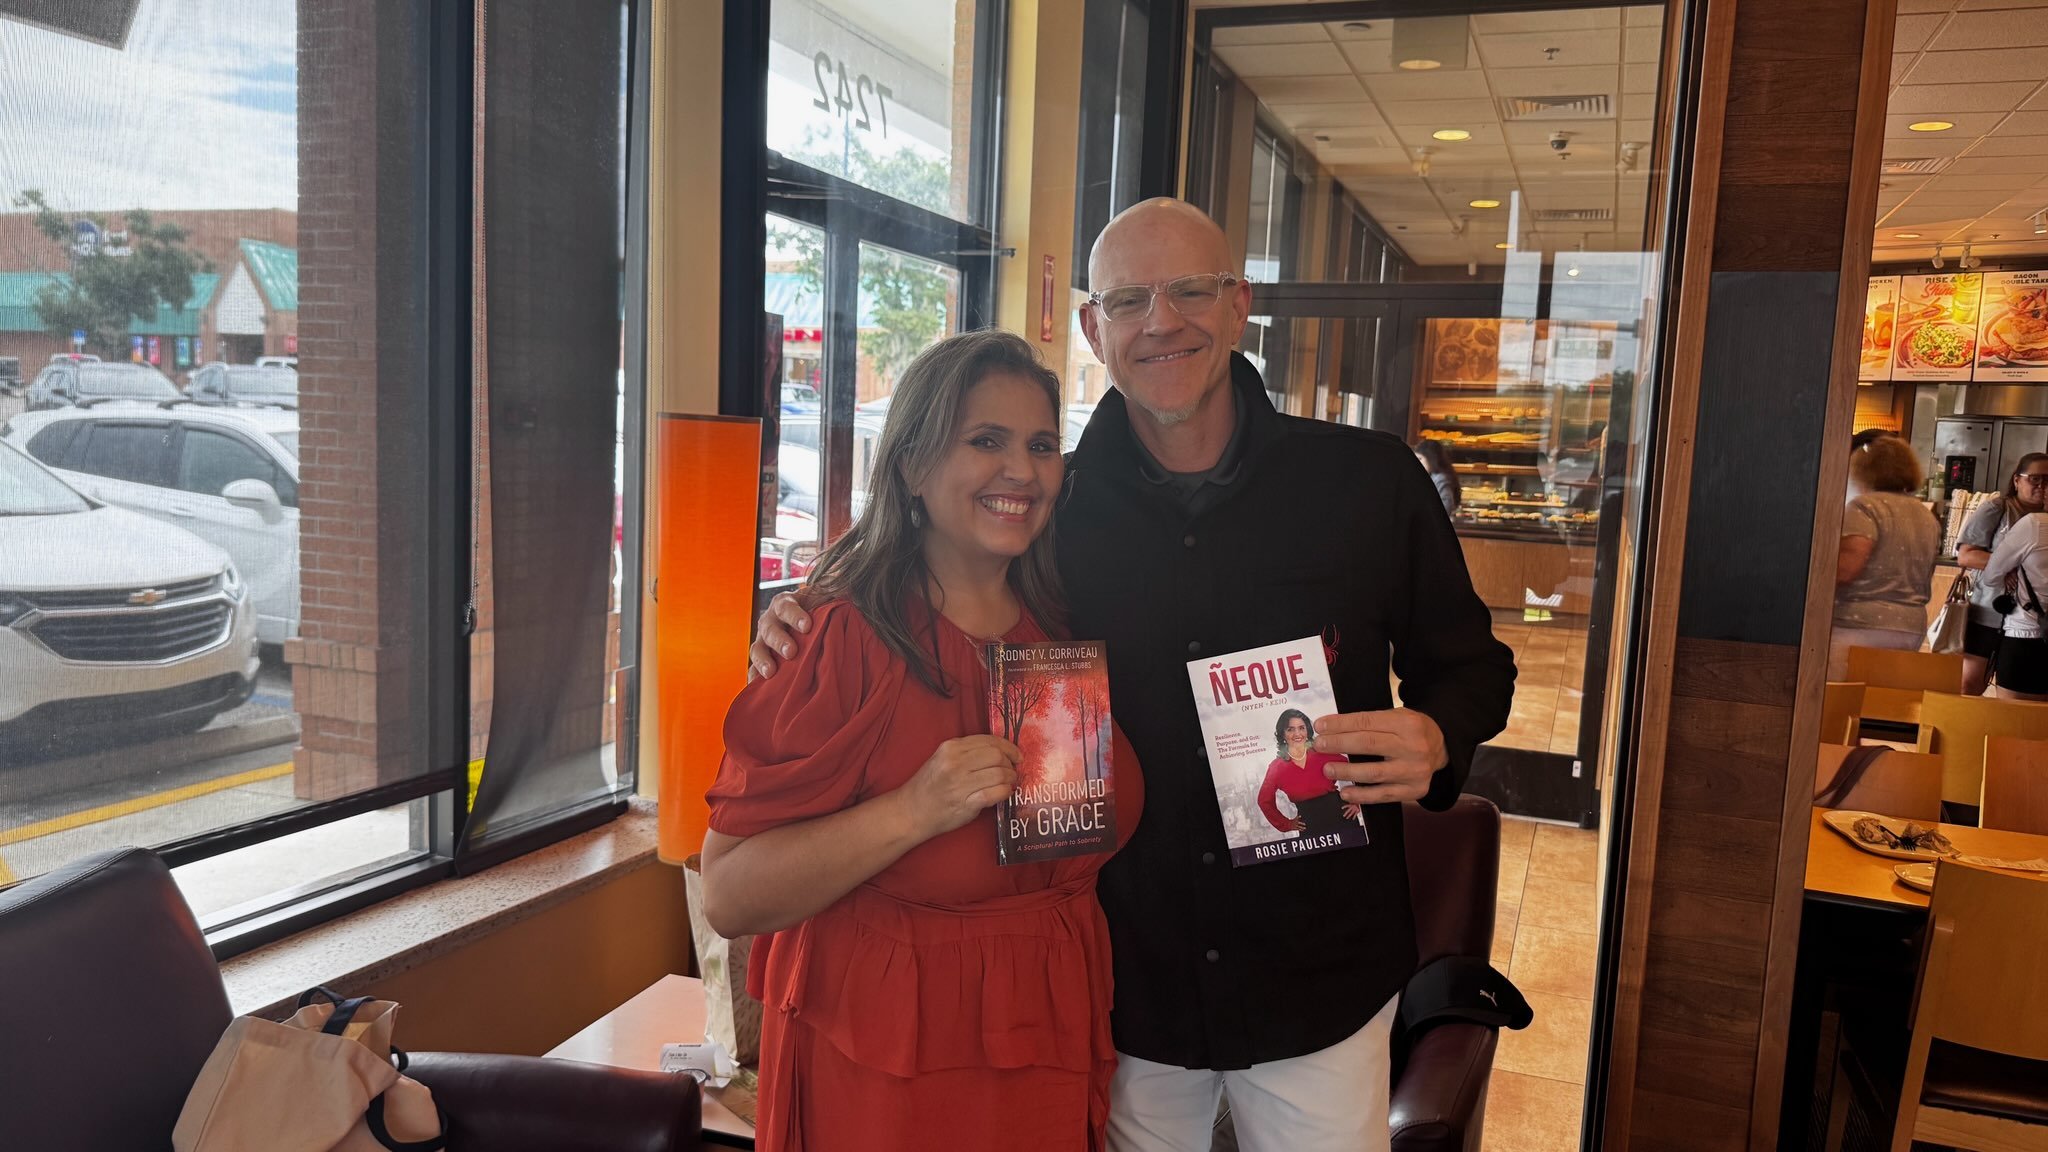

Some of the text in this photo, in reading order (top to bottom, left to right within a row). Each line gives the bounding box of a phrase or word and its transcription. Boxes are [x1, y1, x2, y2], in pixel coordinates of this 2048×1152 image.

[1925, 276, 1948, 284] RISE
[1000, 647, 1098, 662] RODNEY V. CORRIVEAU
[1033, 663, 1065, 672] FRANCESCA
[1071, 661, 1092, 669] STUBBS
[1208, 653, 1310, 707] ÑEQUE
[1220, 747, 1267, 760] Achieving Success
[1228, 743, 1250, 752] Formula
[1010, 802, 1106, 839] BY GRACE
[1023, 841, 1053, 851] Scriptural
[1054, 840, 1068, 848] Path
[1077, 836, 1102, 845] Sobriety
[1255, 832, 1342, 859] ROSIE PAULSEN
